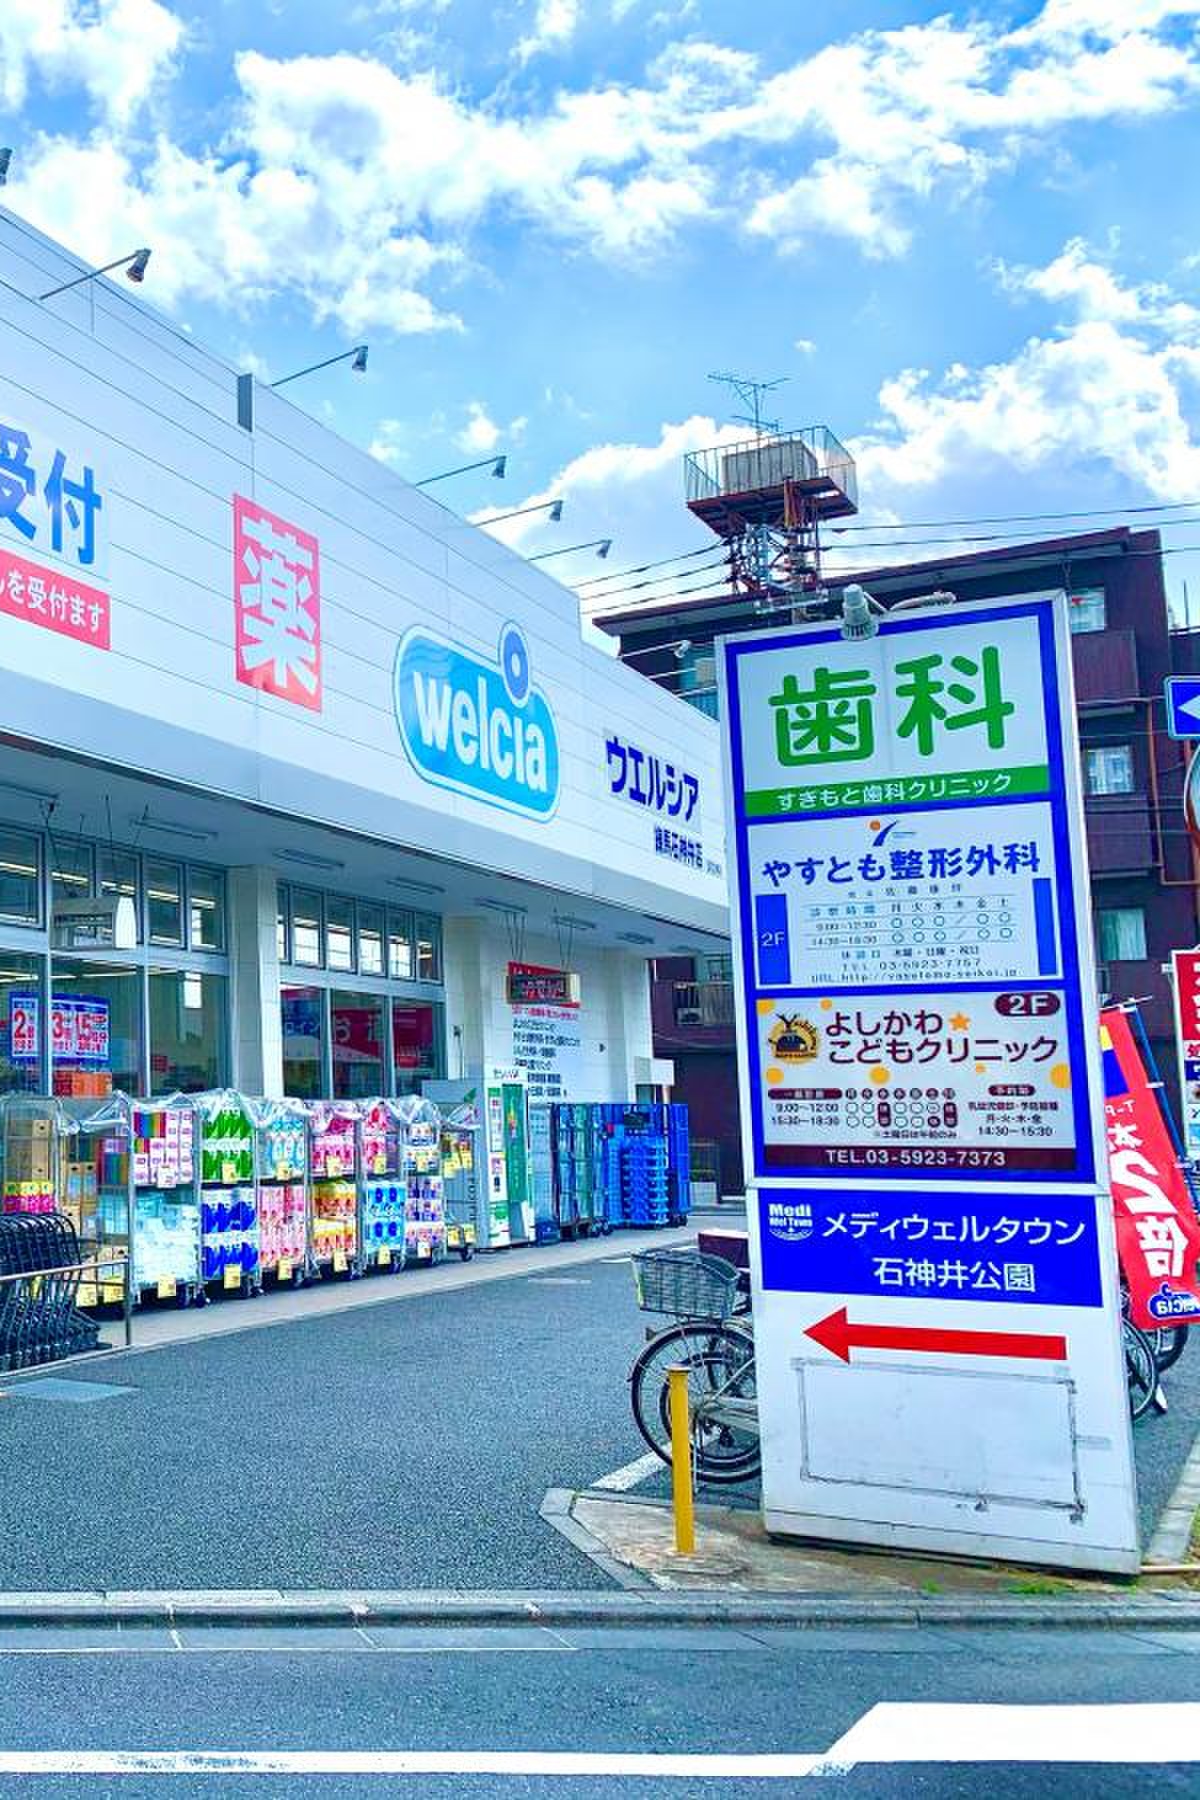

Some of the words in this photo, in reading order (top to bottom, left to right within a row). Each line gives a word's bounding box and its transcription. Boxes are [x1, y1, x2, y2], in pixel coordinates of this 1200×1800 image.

[240, 517, 318, 694] 薬
[769, 645, 1015, 767] 歯科
[413, 671, 548, 793] welcia
[606, 736, 699, 821] ウエルシア
[762, 842, 1040, 887] やすとも整形外科
[761, 932, 785, 946] 2F
[1009, 995, 1049, 1014] 2F
[826, 1011, 943, 1036] よしかわ
[829, 1037, 1058, 1063] こどもクリニック
[826, 1150, 1006, 1167] TEL.03-5923-7373
[823, 1213, 1085, 1245] メディウェルタウン
[873, 1257, 1036, 1293] 石神井公園
